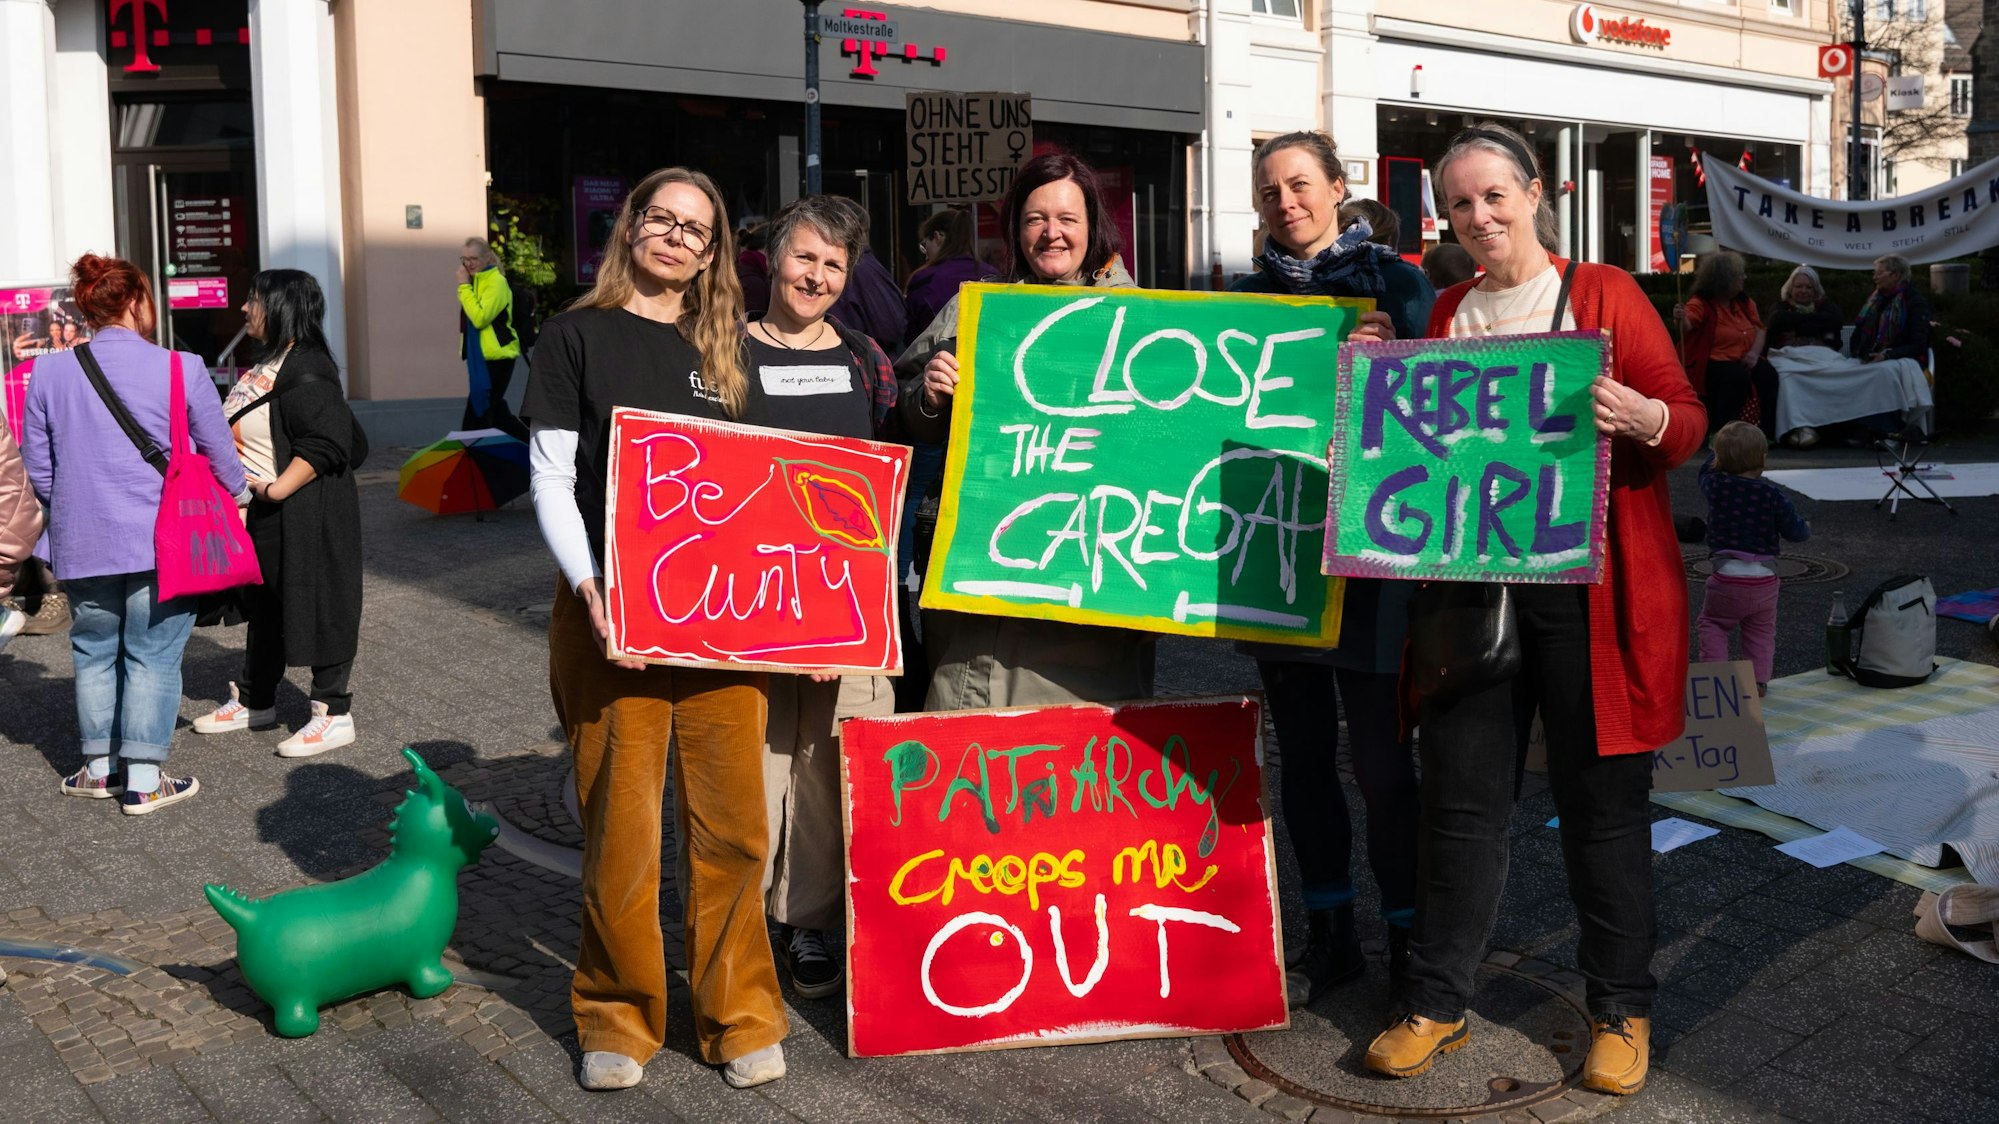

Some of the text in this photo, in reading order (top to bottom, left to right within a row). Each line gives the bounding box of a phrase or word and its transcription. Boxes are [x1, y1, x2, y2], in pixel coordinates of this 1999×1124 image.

[824, 18, 894, 38] Moltkestraße
[1598, 16, 1671, 46] vodafone
[910, 97, 1032, 130] OHNE UNS
[1890, 88, 1919, 97] Kiosk
[910, 131, 990, 167] STEHT
[911, 167, 983, 200] ALLES
[1733, 178, 1999, 233] TAKE A BREAK
[1767, 224, 1971, 250] UND DIE WELT STEHT STILL
[796, 377, 814, 386] your
[1013, 296, 1327, 429] CLOSE
[1360, 357, 1576, 460] REBEL
[1000, 423, 1101, 477] THE
[631, 432, 775, 525] Be
[1364, 461, 1587, 557] GIRL
[1686, 675, 1751, 720] EN-
[1113, 839, 1218, 893] me
[921, 893, 1241, 1018] OUT
